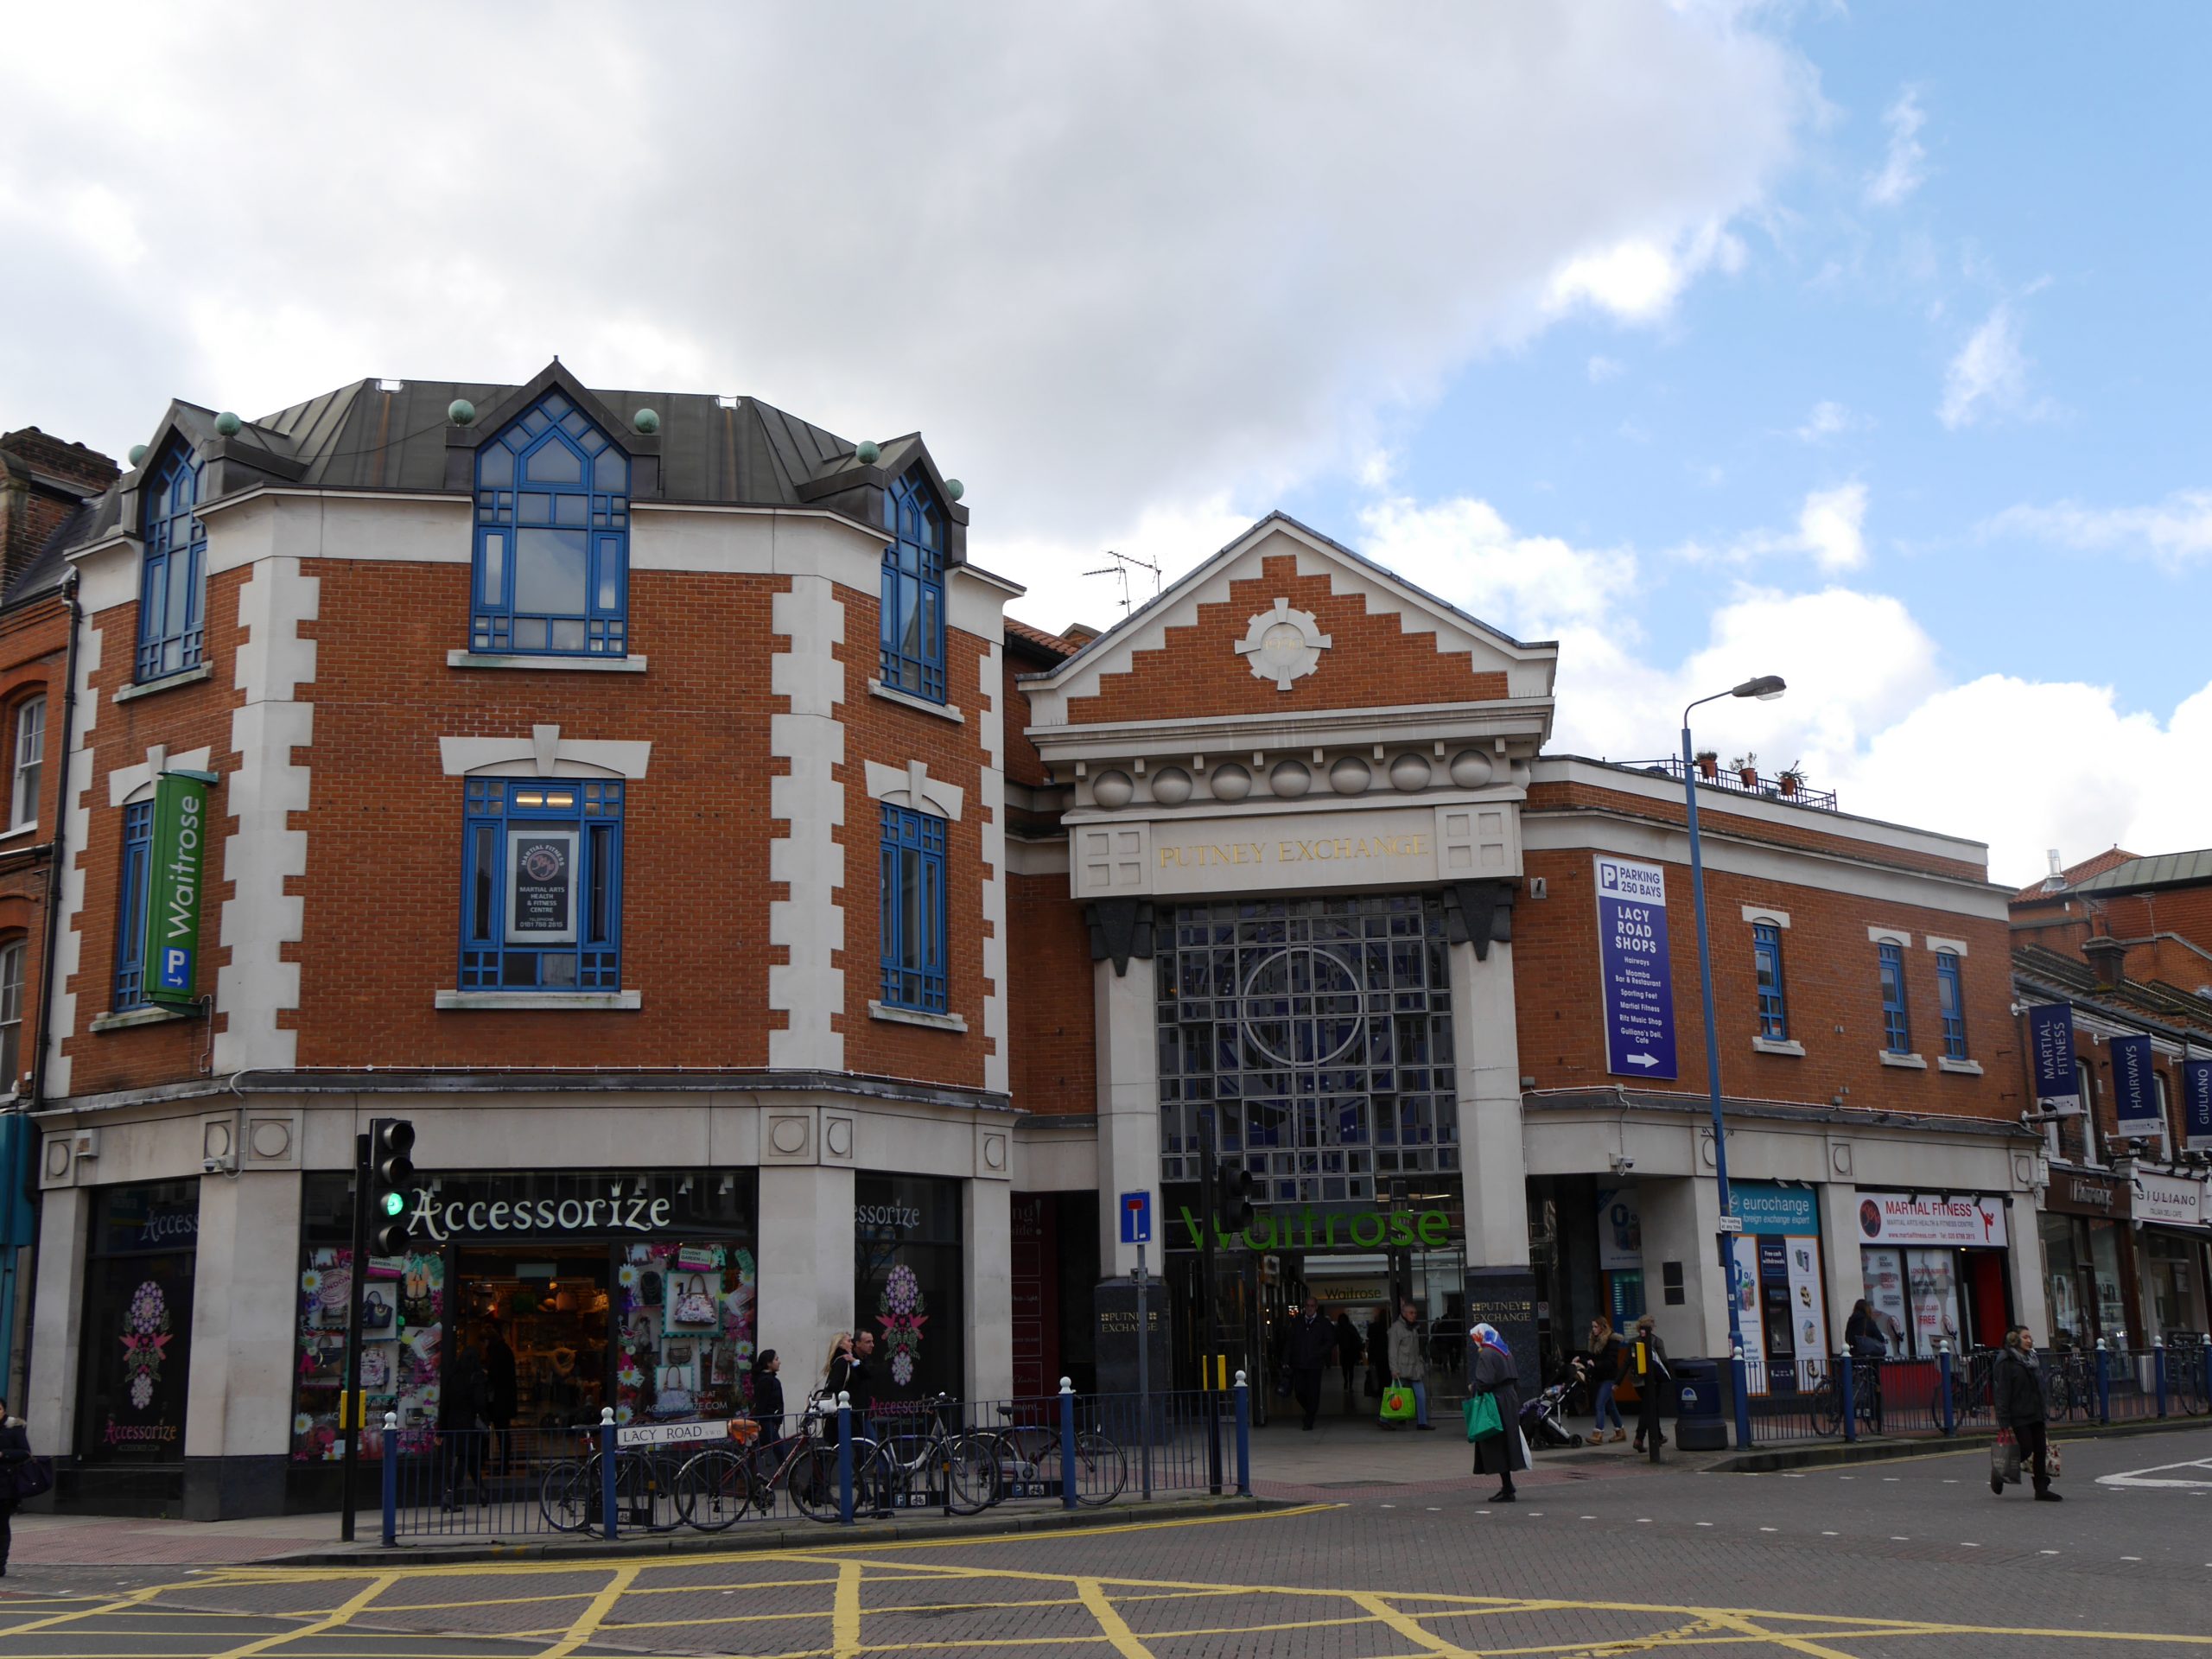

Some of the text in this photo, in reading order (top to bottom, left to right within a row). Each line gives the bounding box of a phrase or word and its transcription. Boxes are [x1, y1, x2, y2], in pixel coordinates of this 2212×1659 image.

[520, 844, 565, 867] MARTIAL FITNESS
[1159, 834, 1428, 868] PUTNEY EXCHANGE
[168, 795, 200, 938] Waitrose
[1620, 867, 1660, 884] PARKING
[1621, 881, 1661, 898] 250 BAYS
[1618, 906, 1649, 923] LACY
[1618, 920, 1652, 938] ROAD
[1615, 936, 1656, 954] SHOPS
[1624, 956, 1649, 967] Hairways
[1625, 969, 1649, 978] Moomba
[1631, 977, 1661, 987] Restaurant
[1620, 988, 1644, 1000] Sporting
[1620, 1001, 1660, 1013] Martial Fitness
[1619, 1014, 1662, 1027] Ritz Music Shop
[2040, 1020, 2055, 1079] MARTIAL
[2054, 1021, 2069, 1075] FITNESS
[2126, 1045, 2142, 1109] HAIRWAYS
[2197, 1068, 2209, 1124] GIULIANO
[406, 1180, 671, 1241] Accessorize
[1743, 1197, 1809, 1216] eurochange
[1885, 1200, 1972, 1217] MARTIAL FITNESS
[1743, 1214, 1810, 1225] foreign exchange expert
[1325, 1287, 1381, 1300] Waitrose
[1481, 1301, 1522, 1312] PUTNEY
[1472, 1313, 1531, 1323] EXCHANGE
[1919, 1315, 1936, 1325] FREE
[103, 1414, 178, 1446] Accessorize
[624, 1428, 657, 1442] LACY
[666, 1426, 702, 1440] ROAD
